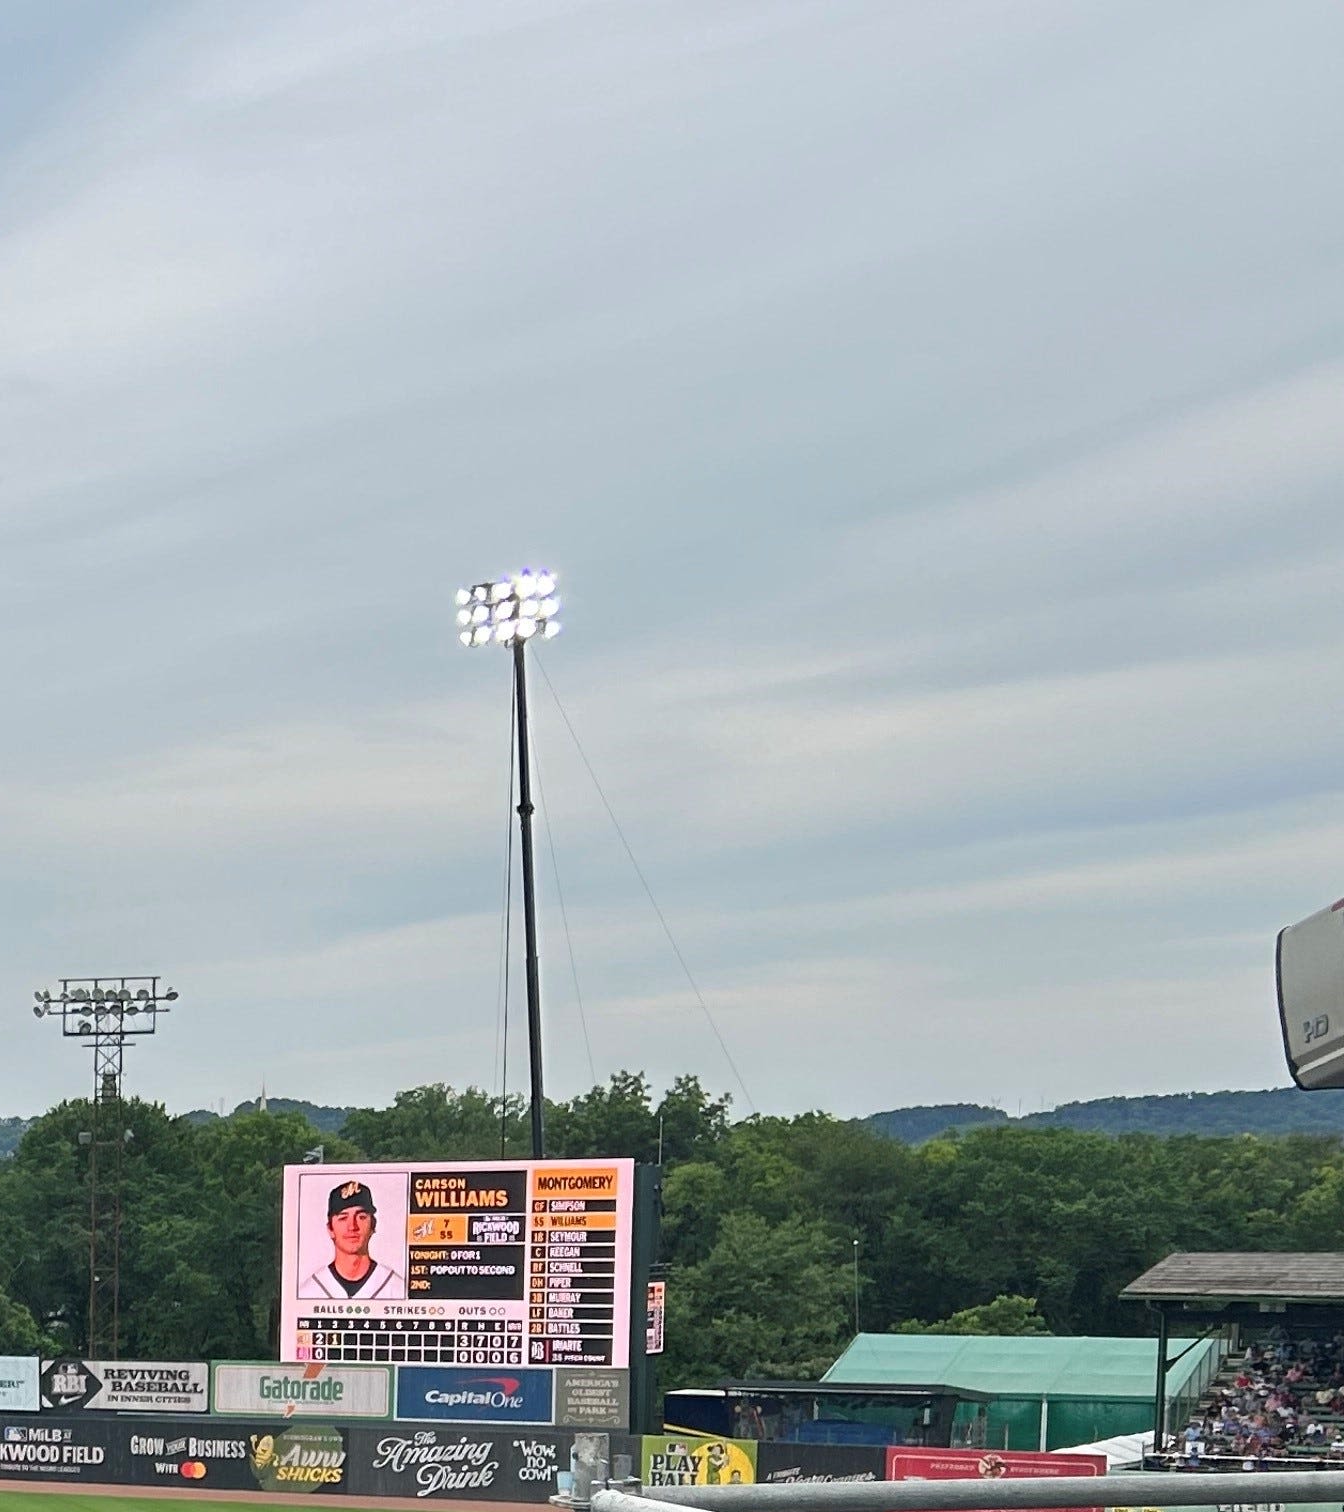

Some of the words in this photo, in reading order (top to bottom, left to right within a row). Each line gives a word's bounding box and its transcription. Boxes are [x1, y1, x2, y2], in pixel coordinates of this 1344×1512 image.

[415, 1178, 466, 1190] CARSON
[537, 1176, 613, 1191] MONTGOMERY
[415, 1190, 509, 1208] WILLIAMS
[472, 1221, 520, 1235] RICKWOOD
[551, 1216, 587, 1227] WILLIAMS
[484, 1232, 508, 1243] FIELD
[550, 1231, 587, 1242] SEYMOUR
[313, 1305, 344, 1314] BALLS
[383, 1305, 427, 1315] STRIKES
[458, 1306, 487, 1315] OUTS
[315, 1333, 324, 1345] 2
[332, 1333, 338, 1345] 1
[460, 1335, 469, 1347] 3
[476, 1335, 485, 1347] 7
[492, 1336, 502, 1347] 0
[510, 1336, 519, 1347] 7
[315, 1349, 324, 1360] 0
[459, 1351, 469, 1362] 0
[475, 1351, 485, 1362] 0
[492, 1351, 501, 1362] 0
[509, 1352, 518, 1363] 6
[103, 1368, 190, 1382] REVIVING
[51, 1373, 89, 1395] RBI
[111, 1381, 204, 1394] BASEBALL
[259, 1375, 344, 1401] Gatorade
[565, 1379, 619, 1388] AMERICA'S
[571, 1388, 610, 1396] OLDEST
[120, 1395, 154, 1403] INNER
[155, 1396, 191, 1404] CITIES
[567, 1397, 619, 1406] BASEBALL
[579, 1407, 606, 1415] PARK
[28, 1428, 62, 1442] MiLB
[414, 1431, 437, 1446] The
[63, 1446, 104, 1464] FIELD
[188, 1437, 246, 1459] BUSINESS
[372, 1436, 494, 1473] Amazing
[527, 1457, 546, 1468] no
[651, 1454, 702, 1472] PLAY
[276, 1467, 344, 1483] SHUCKS
[416, 1461, 499, 1497] Drink
